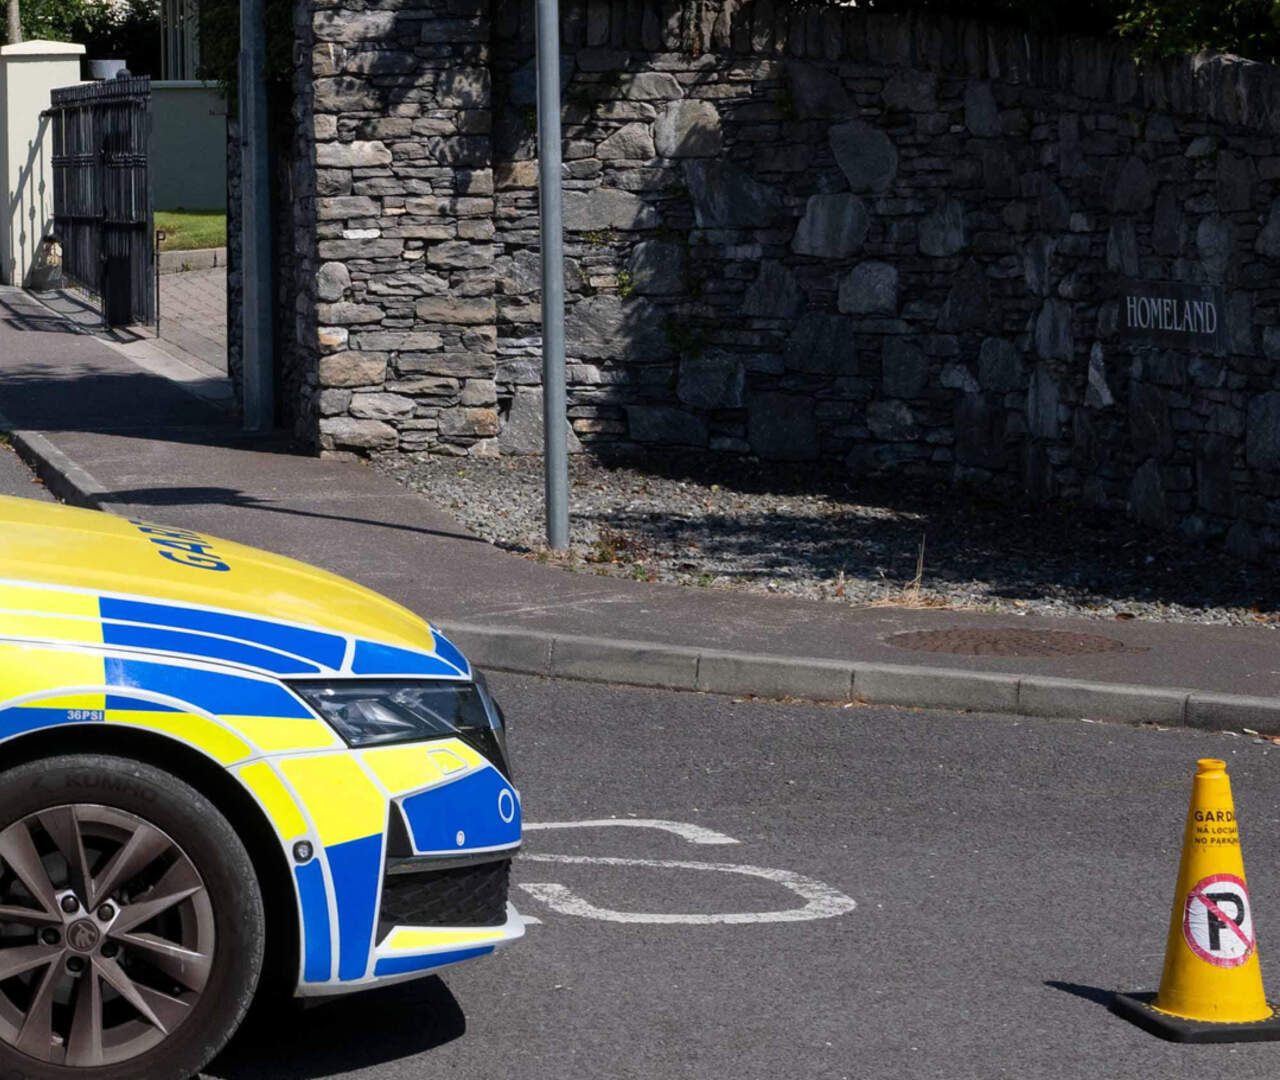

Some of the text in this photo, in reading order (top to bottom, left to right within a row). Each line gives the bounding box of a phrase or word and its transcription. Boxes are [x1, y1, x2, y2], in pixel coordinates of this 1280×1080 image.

[1126, 296, 1217, 334] HOMELAND
[67, 710, 103, 720] 36PSI
[1206, 892, 1245, 951] P
